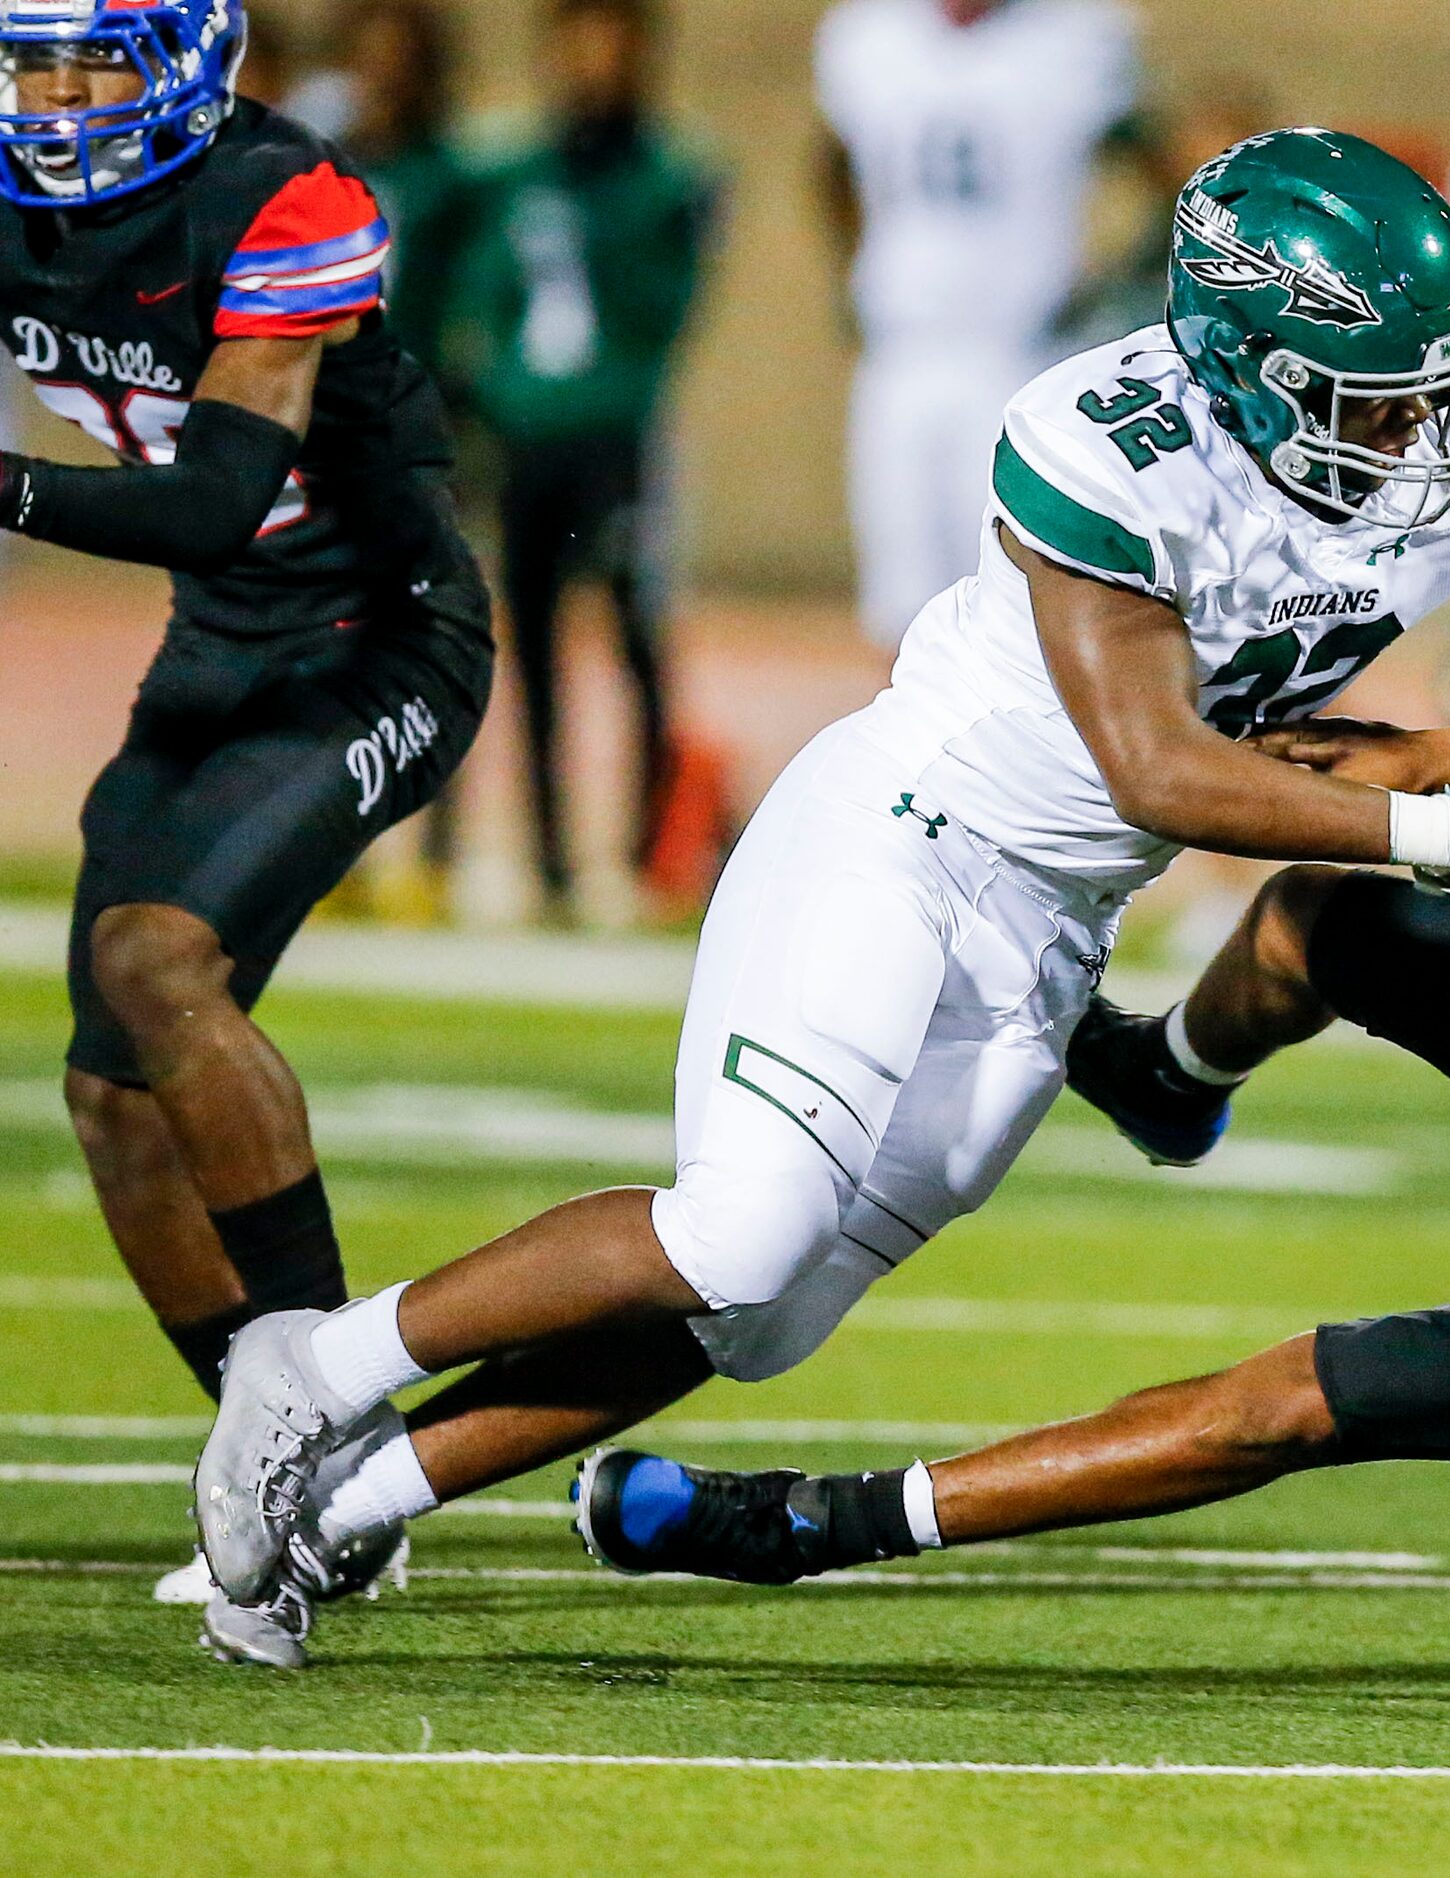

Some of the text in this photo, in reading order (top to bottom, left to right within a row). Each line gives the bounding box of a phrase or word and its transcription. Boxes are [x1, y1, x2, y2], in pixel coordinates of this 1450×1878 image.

[1188, 187, 1240, 236] INDIANS
[12, 314, 183, 392] D'Ville
[1076, 376, 1193, 473] 32
[1305, 411, 1331, 441] Ridd
[1268, 588, 1380, 626] INDIANS
